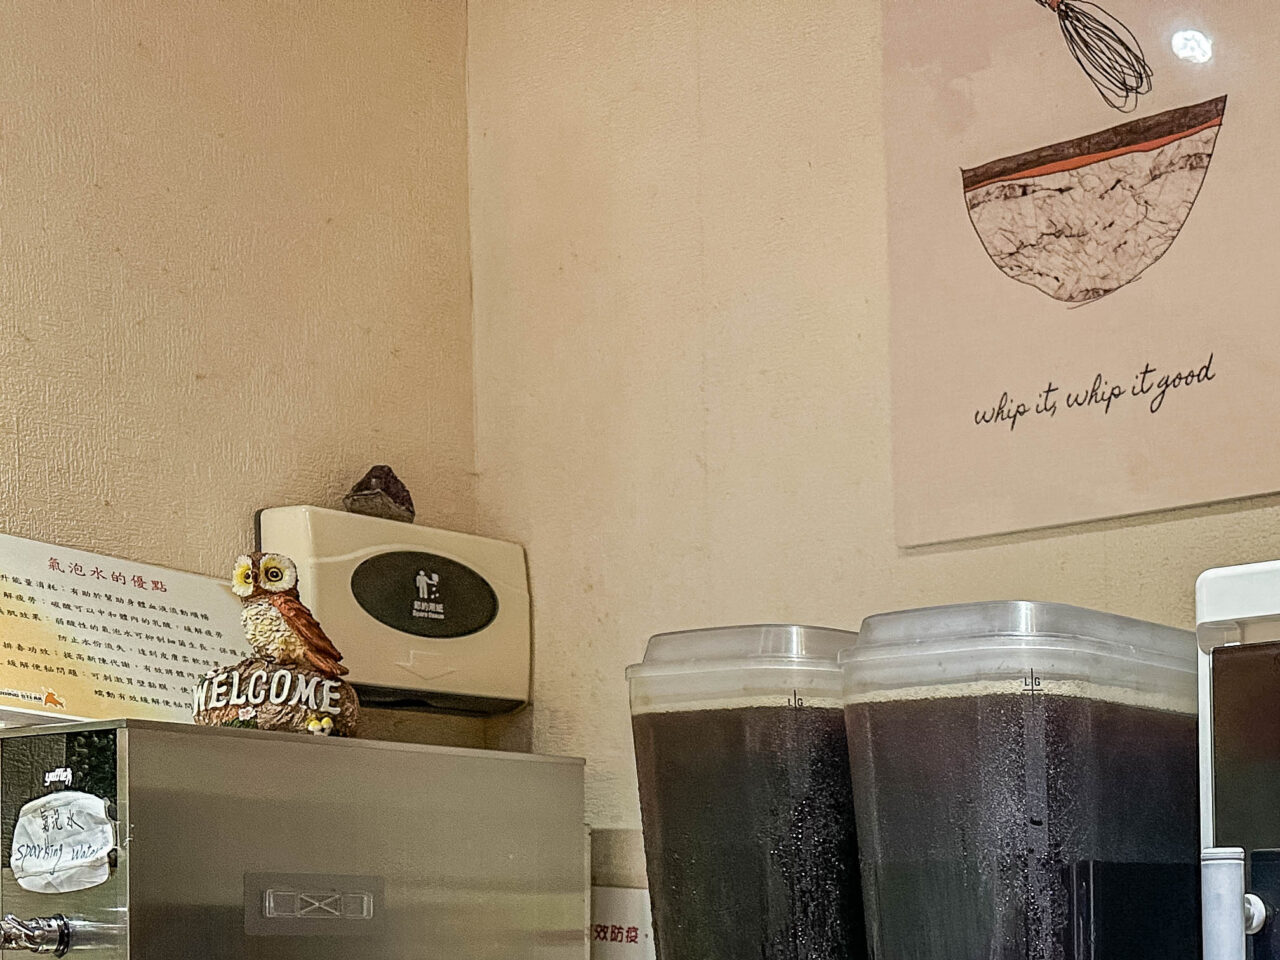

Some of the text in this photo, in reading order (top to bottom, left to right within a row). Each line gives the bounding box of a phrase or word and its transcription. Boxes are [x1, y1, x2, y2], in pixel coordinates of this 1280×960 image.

[974, 352, 1216, 431] whip it, whip it good
[48, 556, 168, 593] 氣泡水的優點
[192, 669, 341, 717] WELCOME
